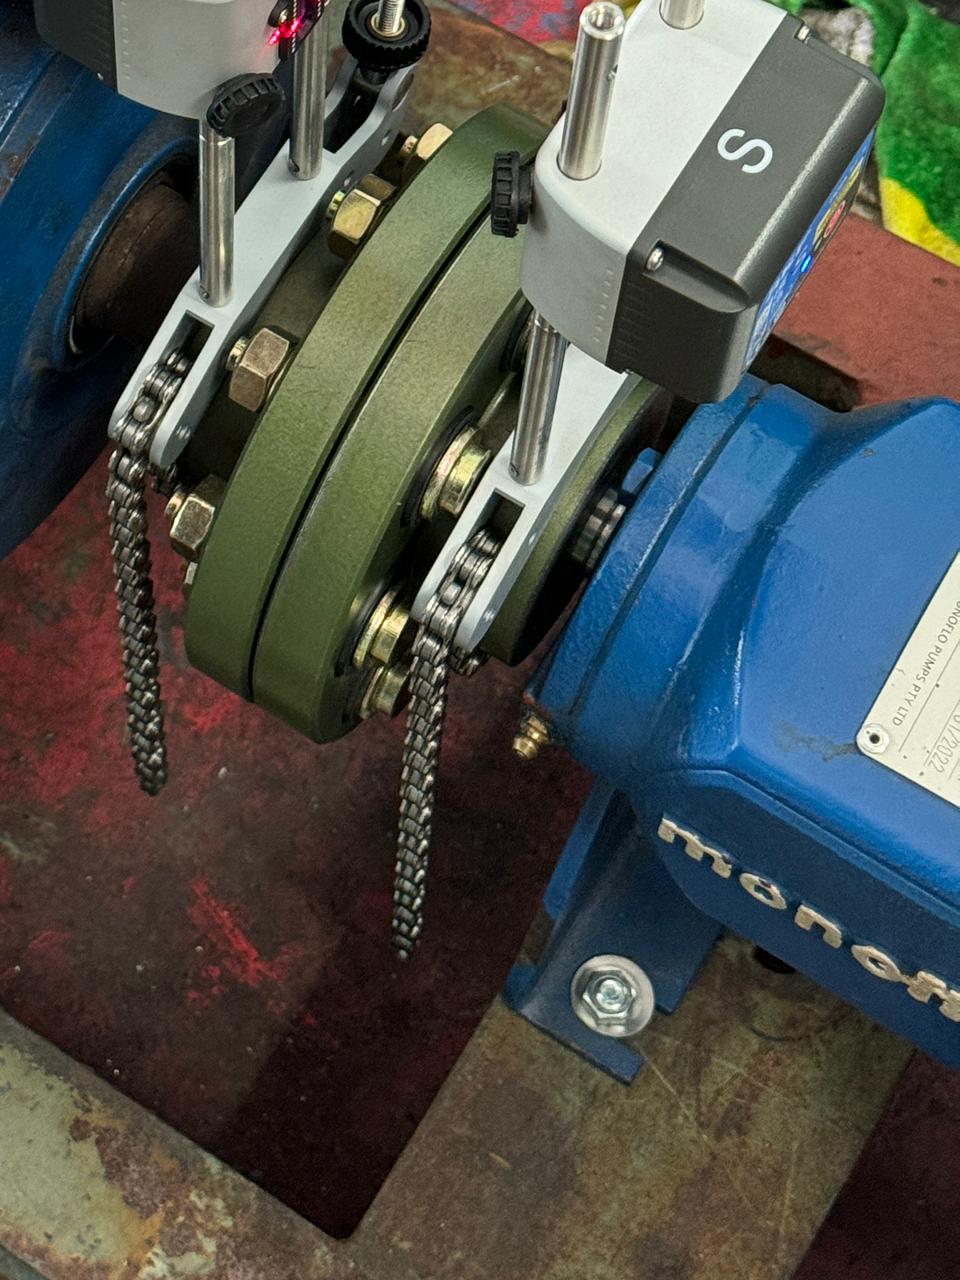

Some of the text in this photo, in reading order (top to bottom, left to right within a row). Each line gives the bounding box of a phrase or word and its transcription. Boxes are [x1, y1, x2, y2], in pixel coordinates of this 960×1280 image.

[717, 128, 774, 174] S
[916, 645, 942, 682] PUMPS
[904, 684, 921, 706] PTY
[892, 706, 908, 726] LTD
